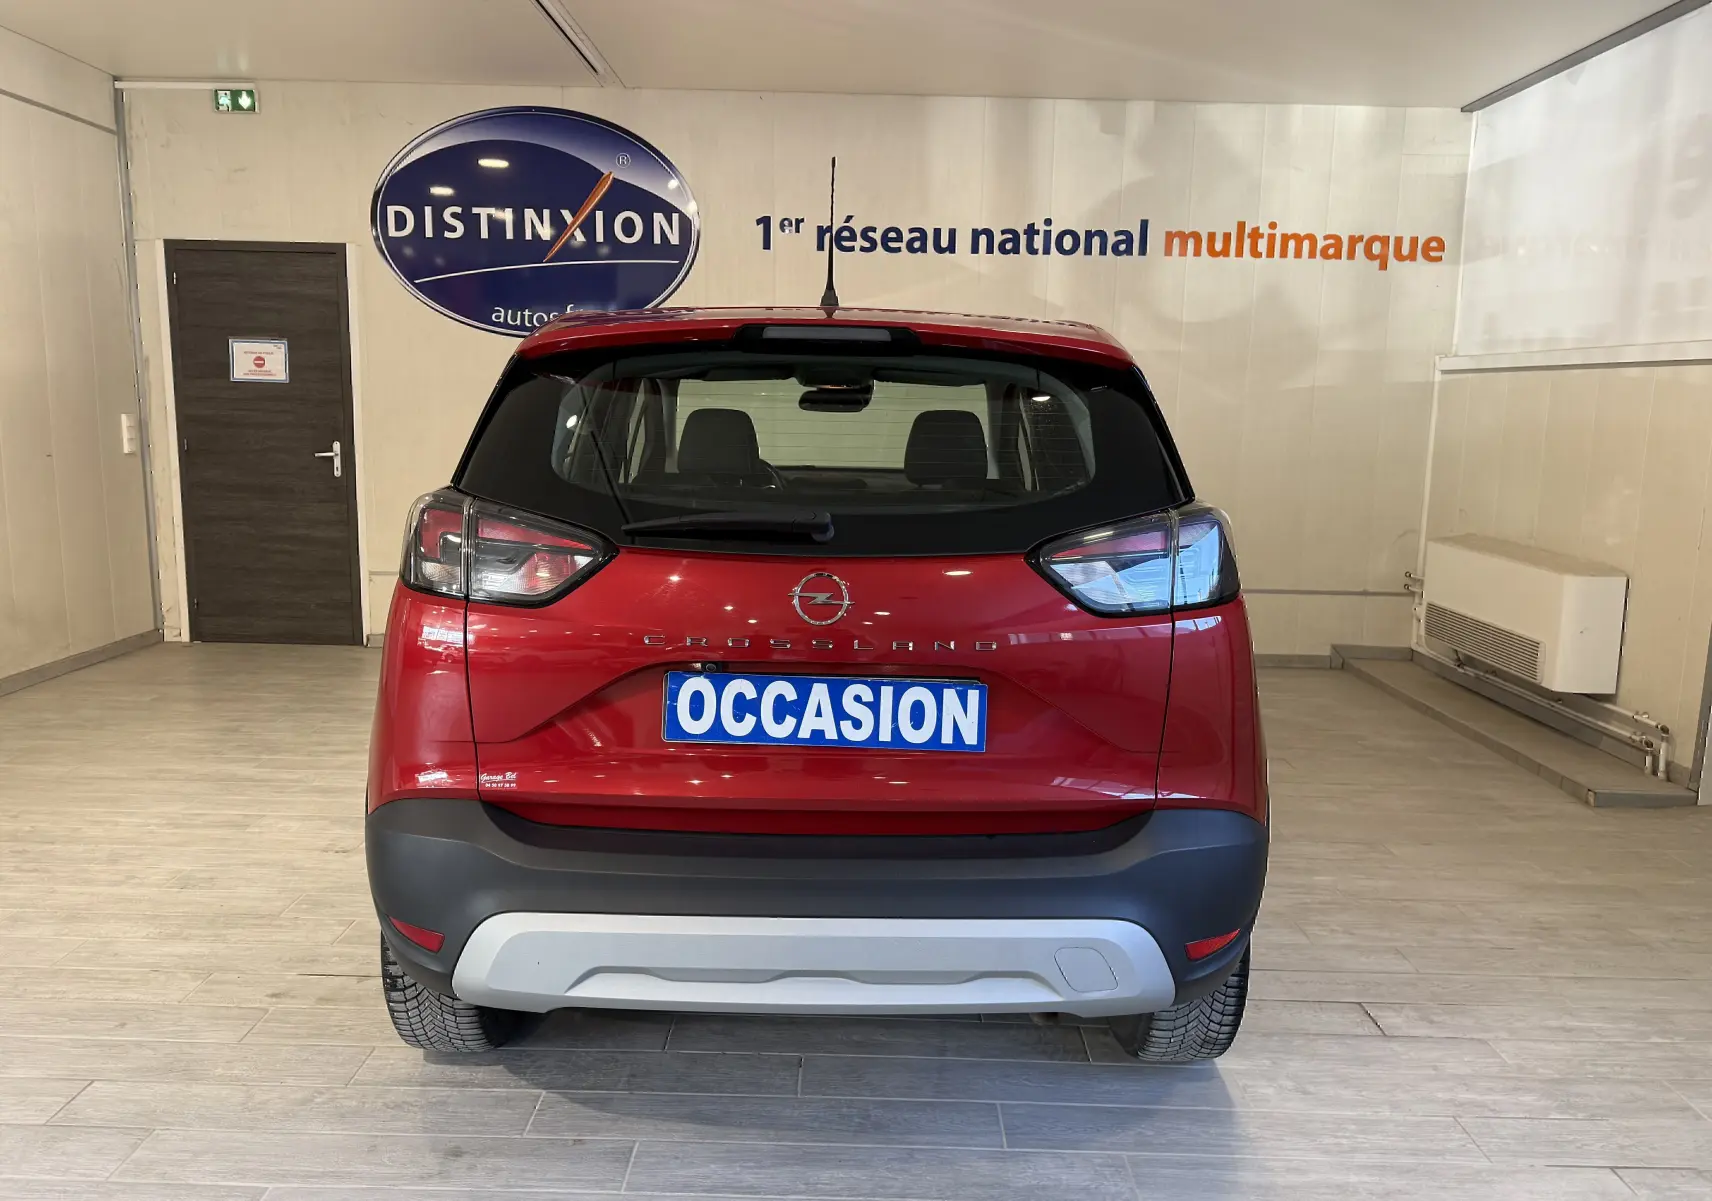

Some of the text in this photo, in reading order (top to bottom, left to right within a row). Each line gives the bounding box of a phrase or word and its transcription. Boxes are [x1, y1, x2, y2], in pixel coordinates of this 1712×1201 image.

[386, 205, 680, 245] DISTINXION
[816, 215, 957, 255] réseau
[971, 218, 1150, 256] national
[1164, 221, 1446, 271] multimarque
[644, 634, 998, 651] CROSSLAND
[676, 676, 980, 746] OCCASION
[480, 773, 504, 783] Garage
